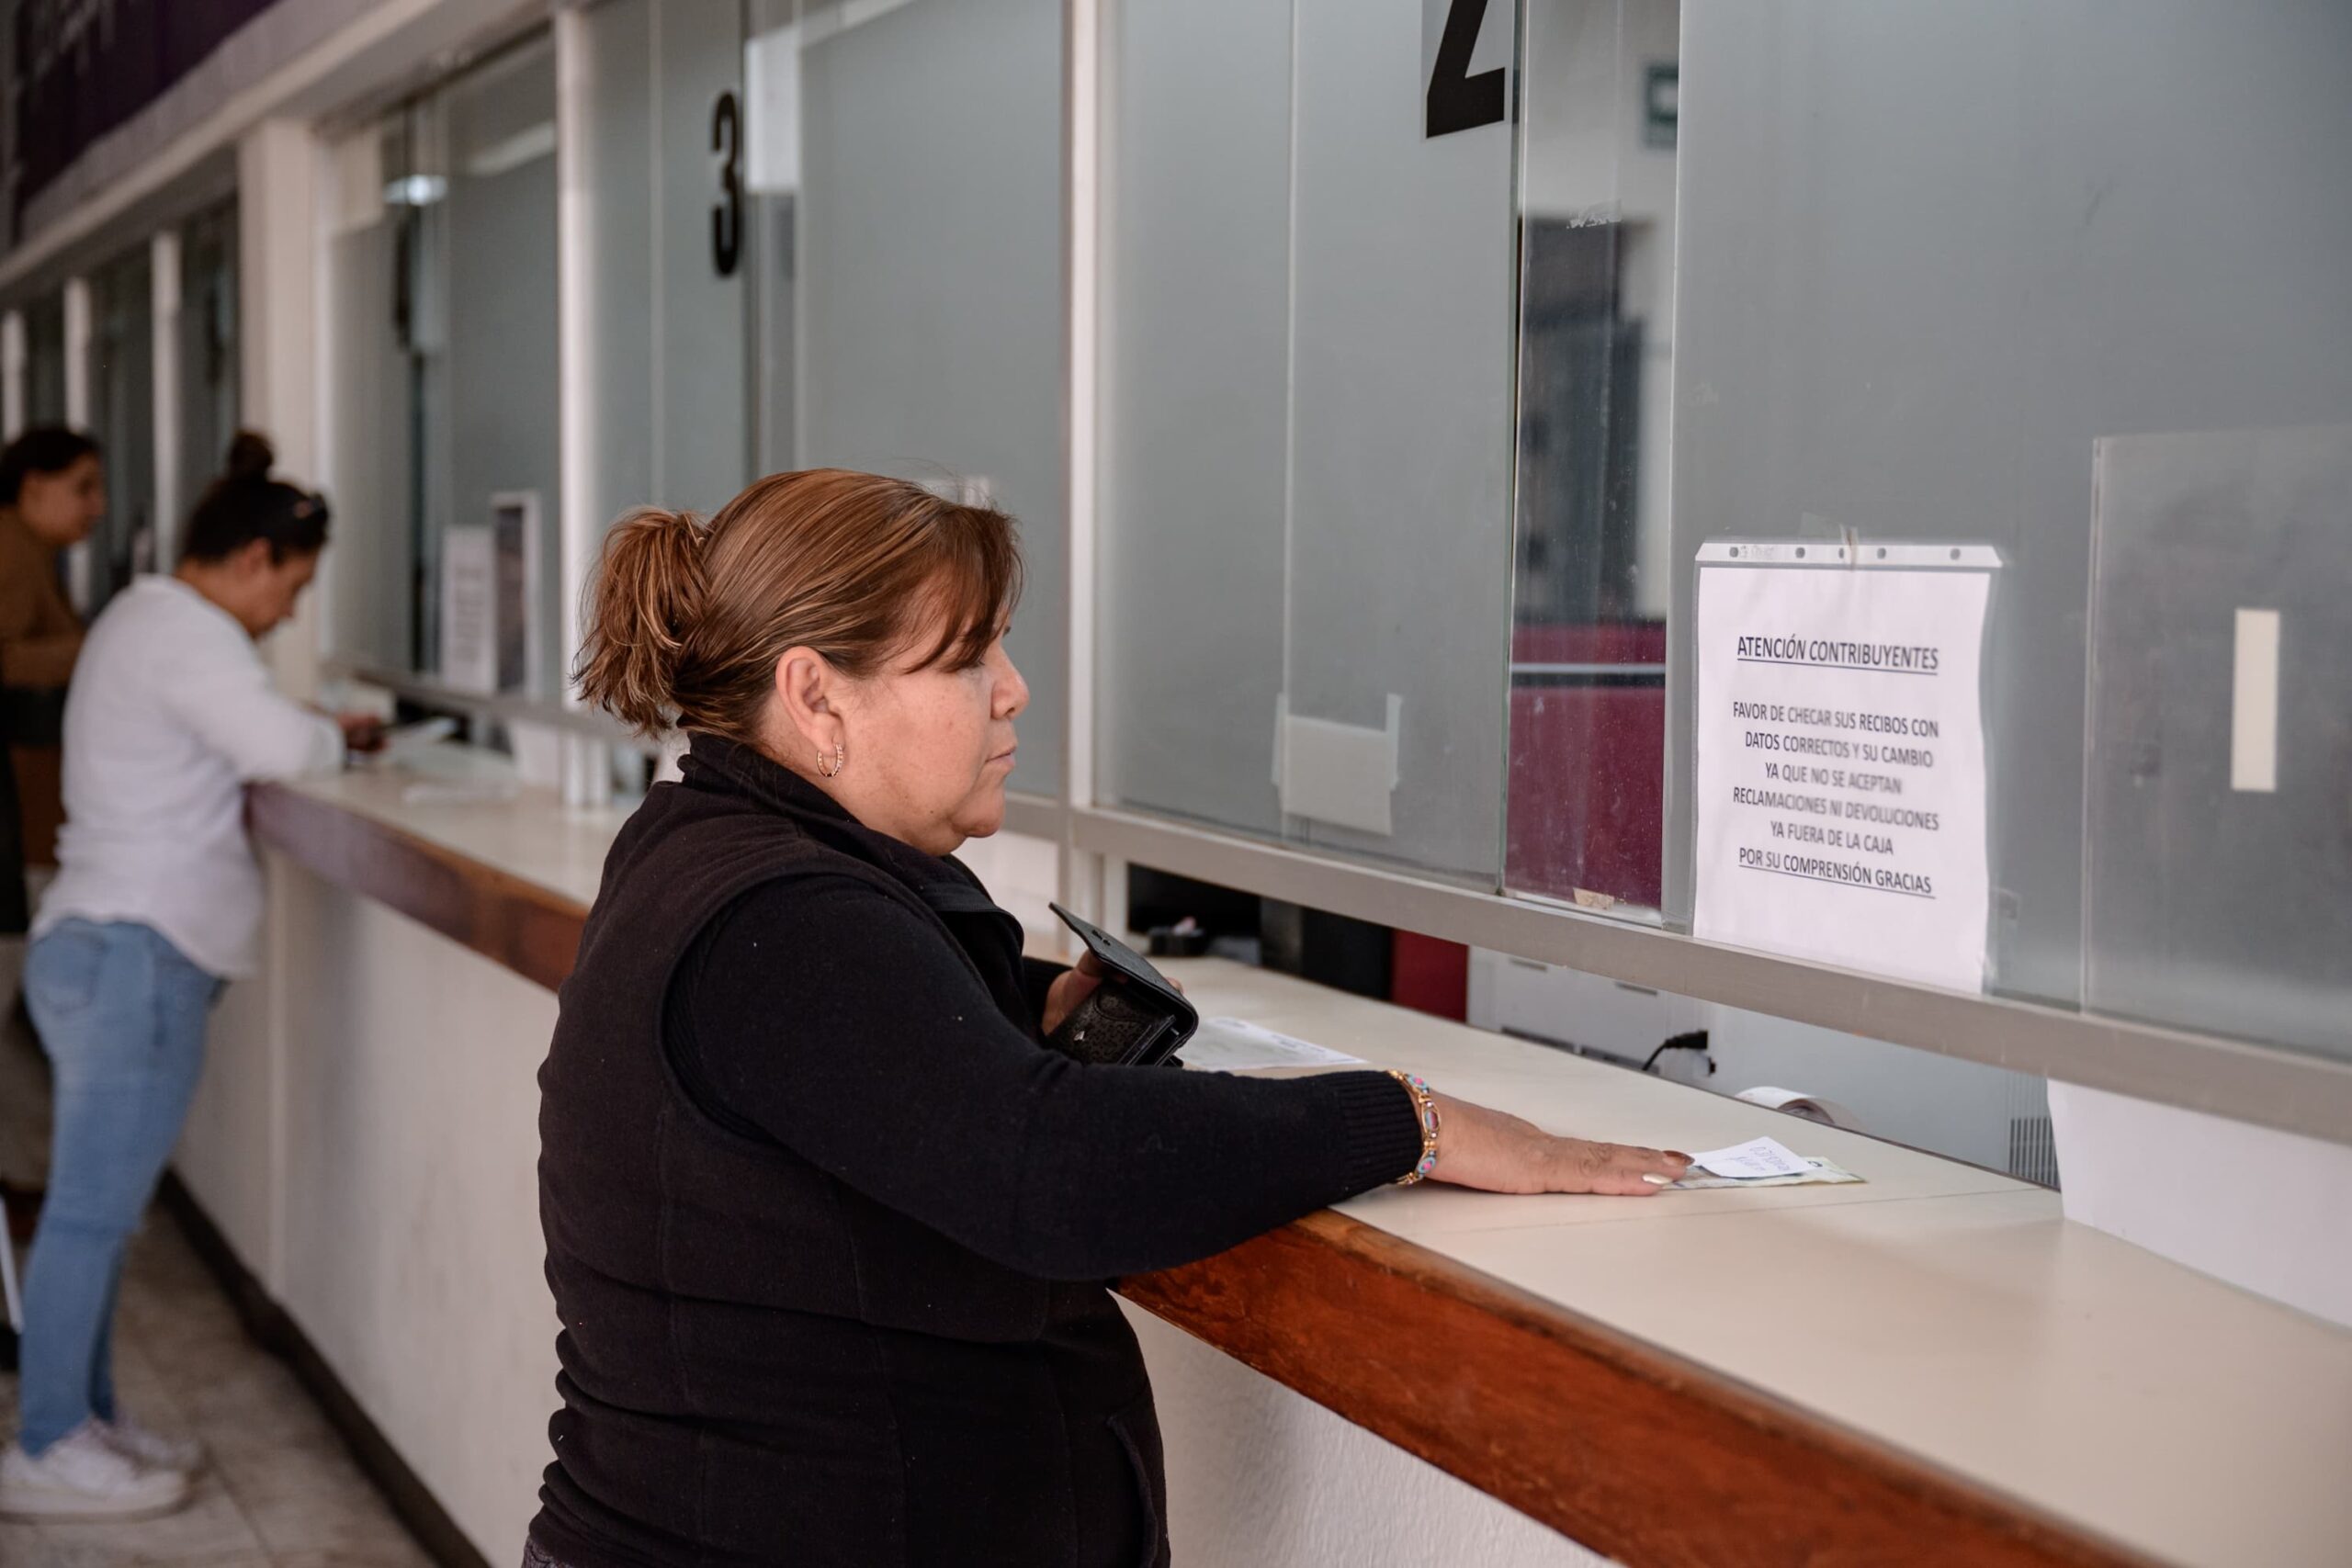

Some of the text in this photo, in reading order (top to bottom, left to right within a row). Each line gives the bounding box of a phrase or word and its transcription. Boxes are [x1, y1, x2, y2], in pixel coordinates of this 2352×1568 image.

[711, 90, 740, 277] 3
[1737, 634, 1939, 671] ATENCIÓN CONTRIBUYENTES
[1734, 702, 1939, 738] FAVOR DE CHECAR SUS RECIBOS CON
[1745, 731, 1933, 769] DATOS CORRECTOS Y SU CAMBIO
[1765, 761, 1902, 795] YA QUE NO SE ACEPTAN
[1734, 786, 1939, 831] RECLAMACIONES NI DEVOLUCIONES
[1771, 820, 1894, 854] YA FUERA DE LA CAJA
[1739, 848, 1932, 894] POR SU COMPRENSIÓN GRACIAS
